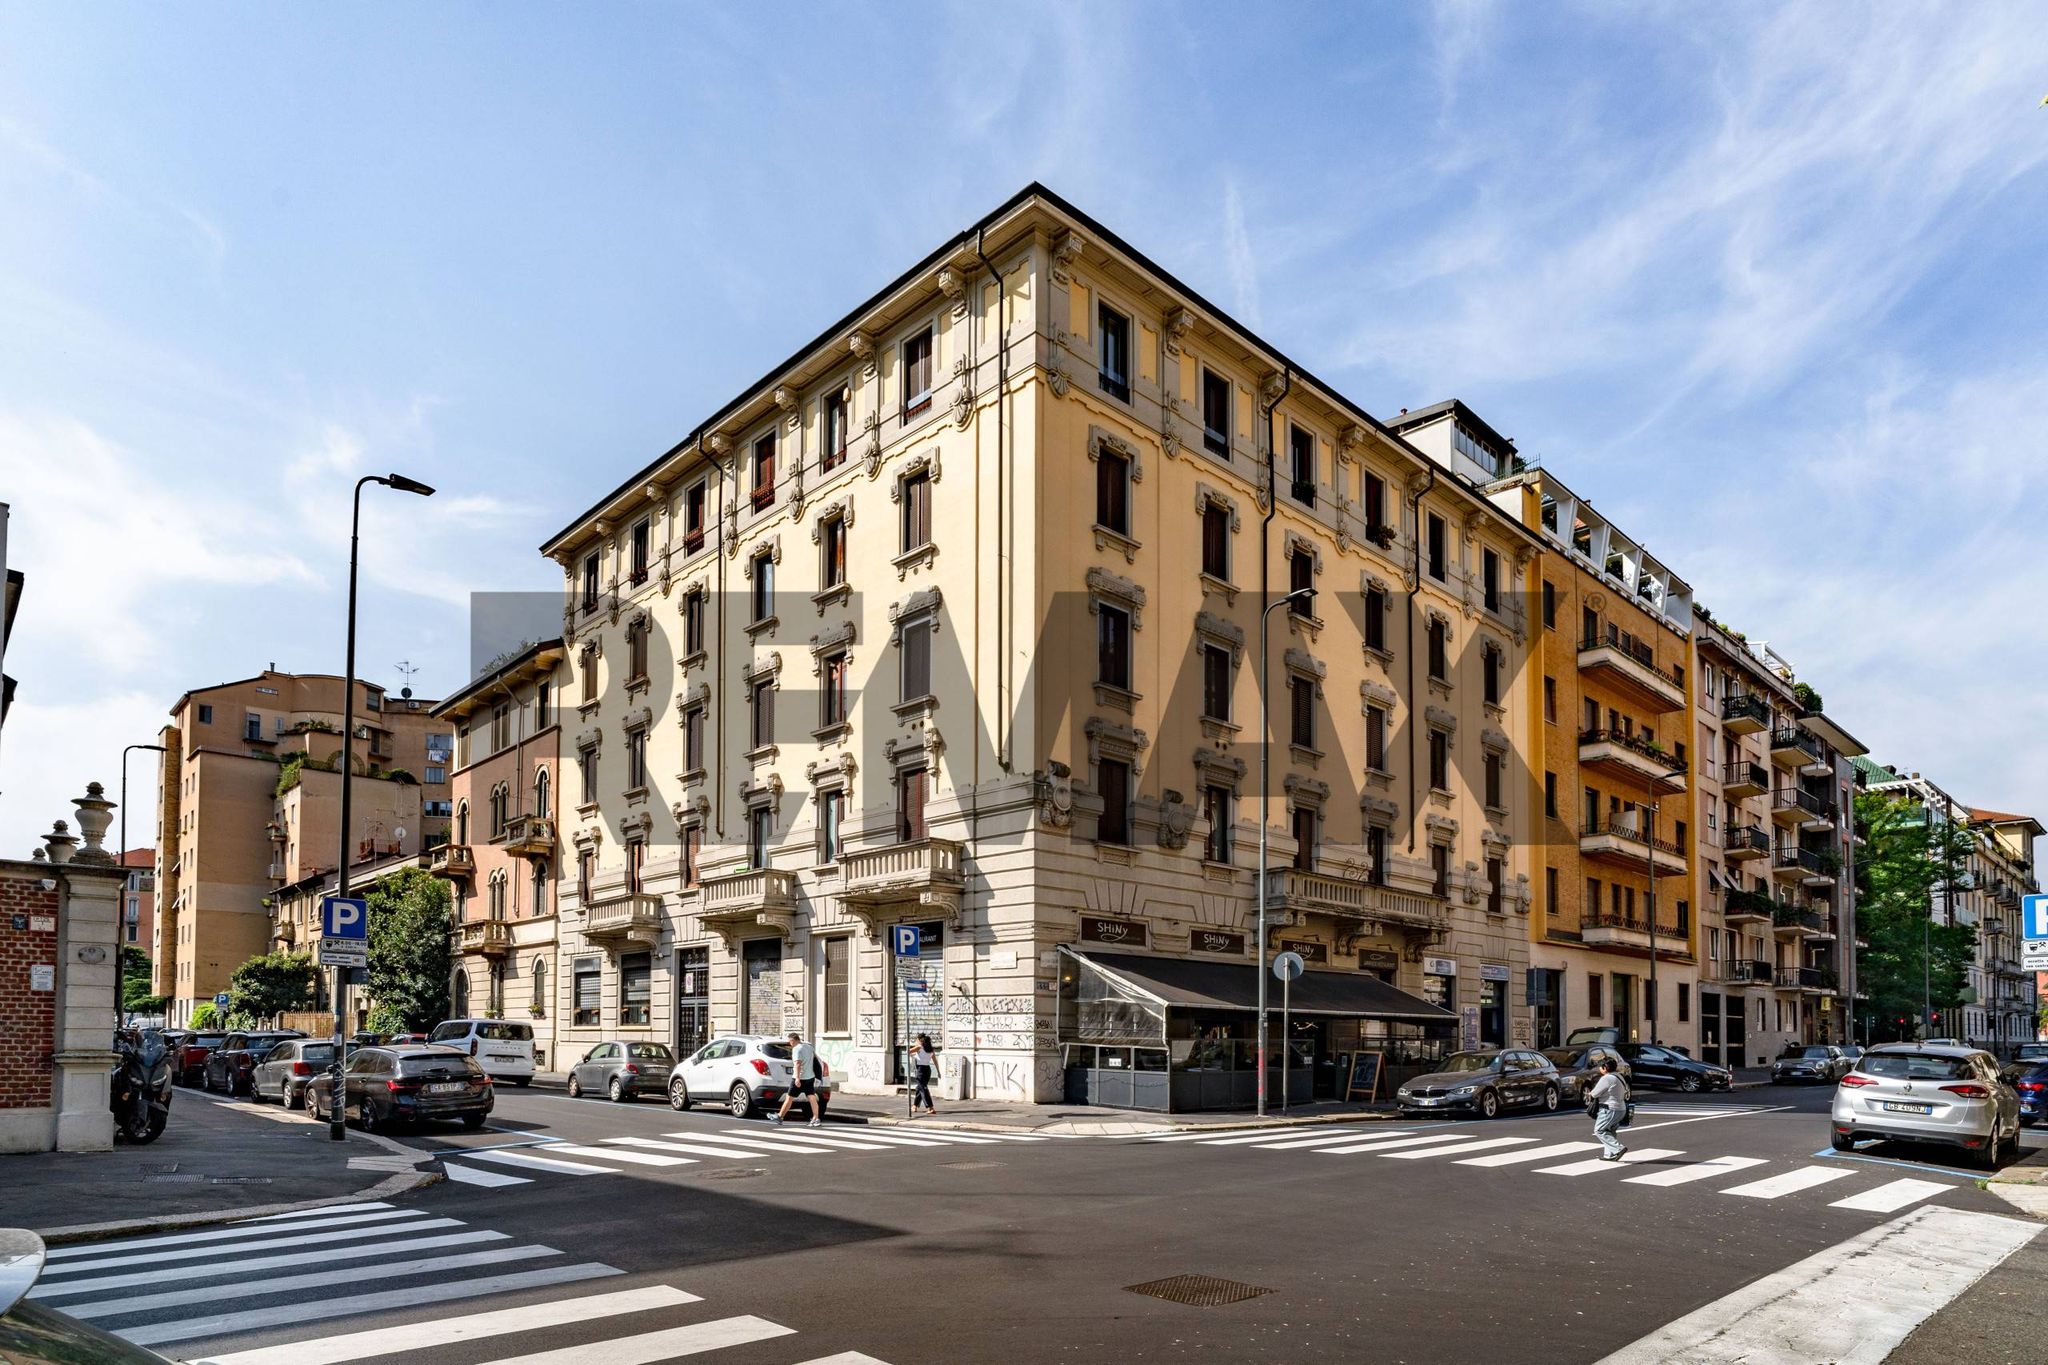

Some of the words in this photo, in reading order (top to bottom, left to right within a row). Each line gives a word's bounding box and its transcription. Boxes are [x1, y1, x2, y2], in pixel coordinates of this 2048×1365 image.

[332, 902, 359, 933] P
[900, 929, 915, 953] P
[218, 995, 227, 1003] P
